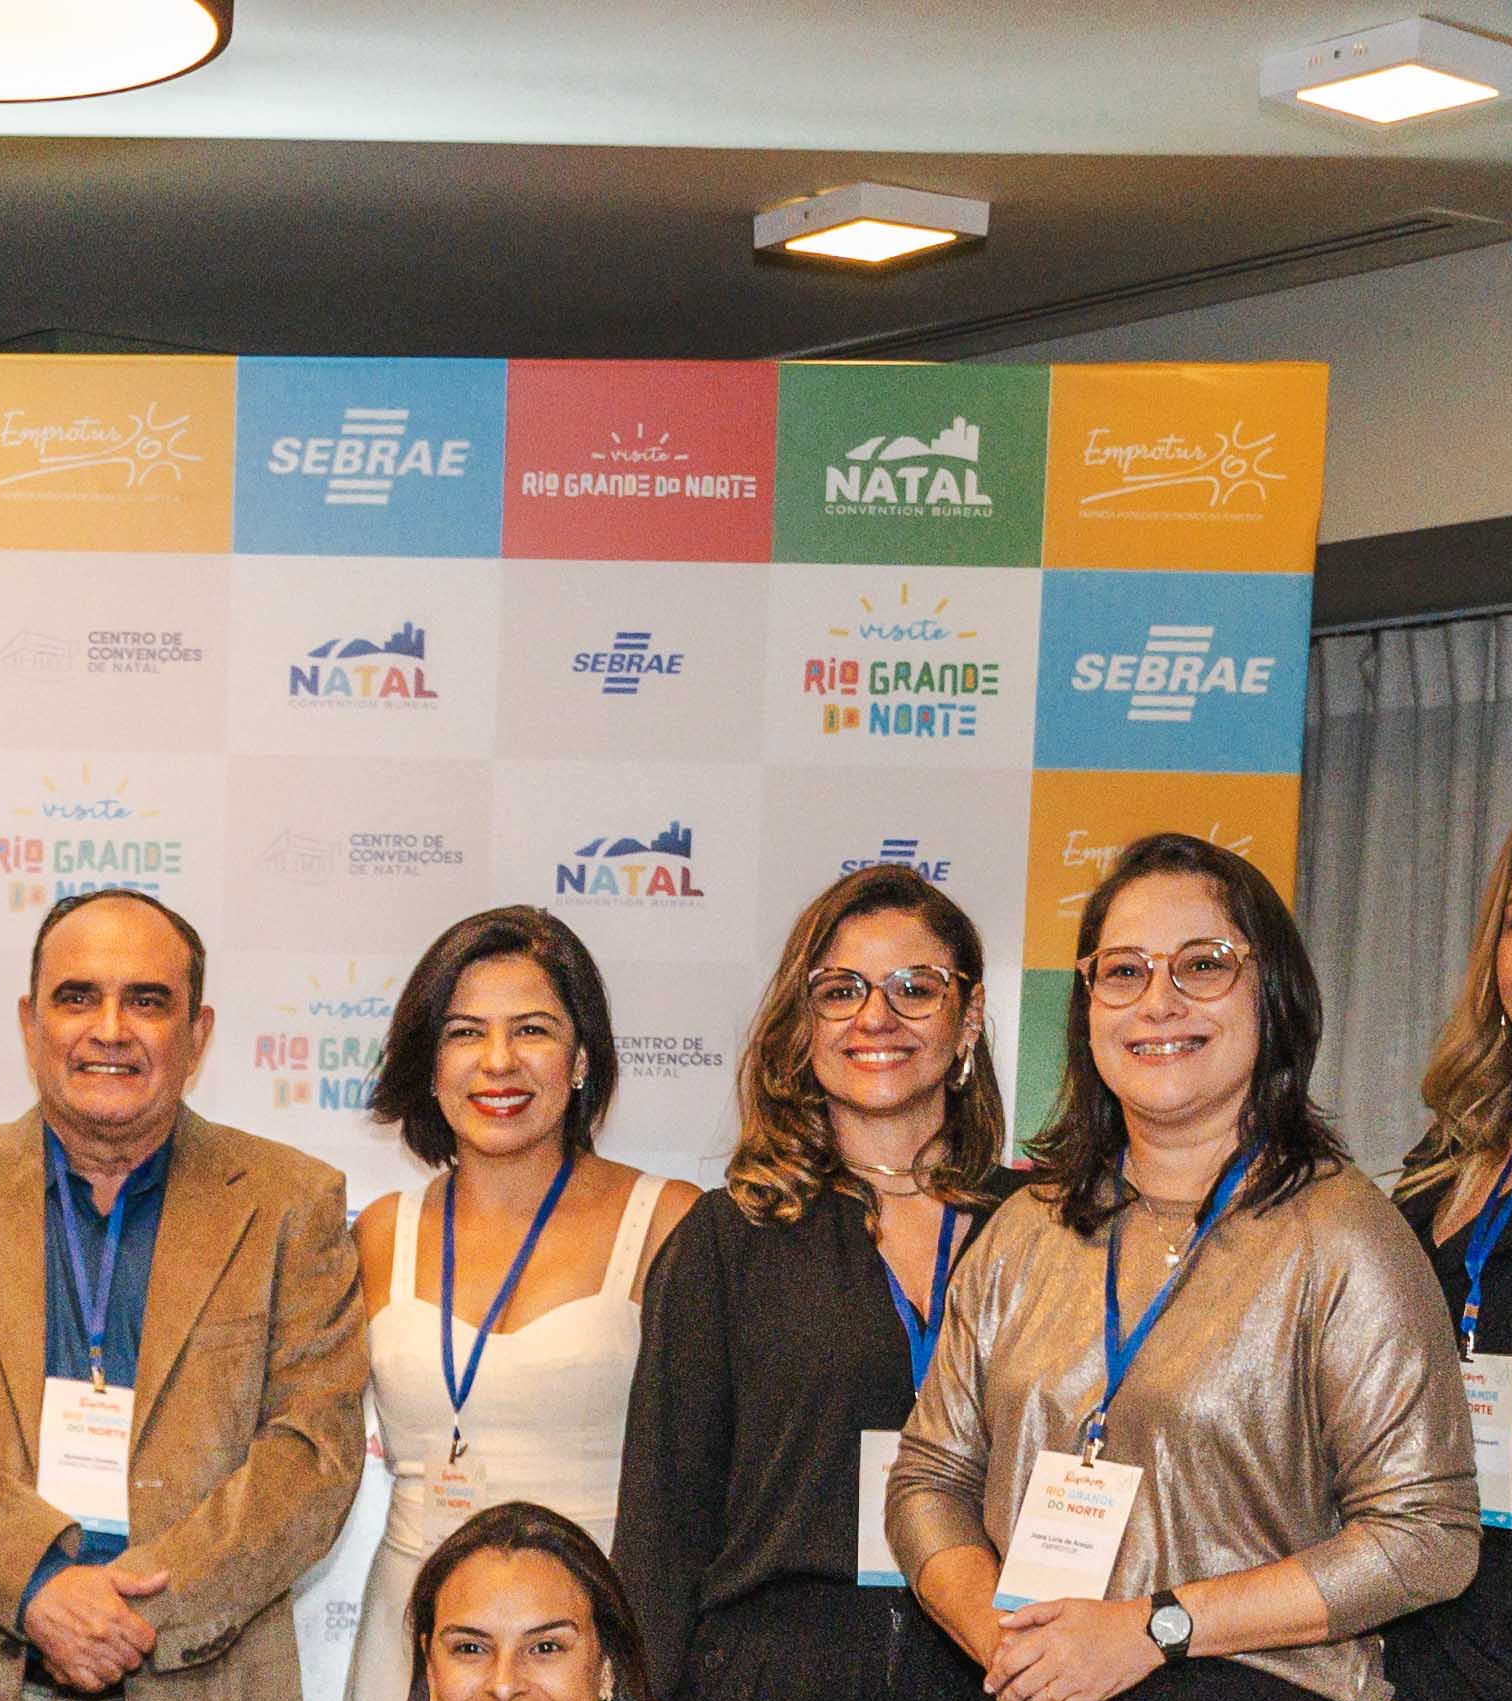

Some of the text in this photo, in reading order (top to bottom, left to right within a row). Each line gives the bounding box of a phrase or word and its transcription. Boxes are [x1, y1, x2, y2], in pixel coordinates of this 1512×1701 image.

[268, 438, 471, 477] SEBRAE
[609, 447, 672, 464] visite
[1083, 428, 1207, 474] Emprotur
[564, 473, 650, 498] GRANDE
[655, 474, 681, 498] DO
[685, 474, 757, 499] NORTE
[825, 466, 993, 505] NATAL
[824, 504, 994, 518] CONVENTION BUREAU
[88, 631, 182, 646] CENTRO DE
[859, 619, 951, 641] visite
[88, 645, 203, 663] CONVENÇÕES
[572, 653, 684, 675] SEBRAE
[88, 662, 160, 674] DE NATAL
[869, 661, 999, 695] GRANDE
[1071, 654, 1275, 694] SEBRAE
[289, 665, 439, 698] NATAL
[822, 704, 976, 737] DO NORTE
[42, 800, 134, 820] visite
[350, 834, 443, 849] CENTRO DE
[52, 839, 182, 874] GRANDE
[350, 847, 464, 866] CONVENÇÕES
[350, 865, 420, 877] DE NATAL
[555, 864, 704, 897] NATAL
[682, 1038, 704, 1050] DE
[633, 1068, 681, 1079] NATAL
[1046, 1487, 1066, 1498] RIO
[1047, 1501, 1106, 1520] DO NORTE
